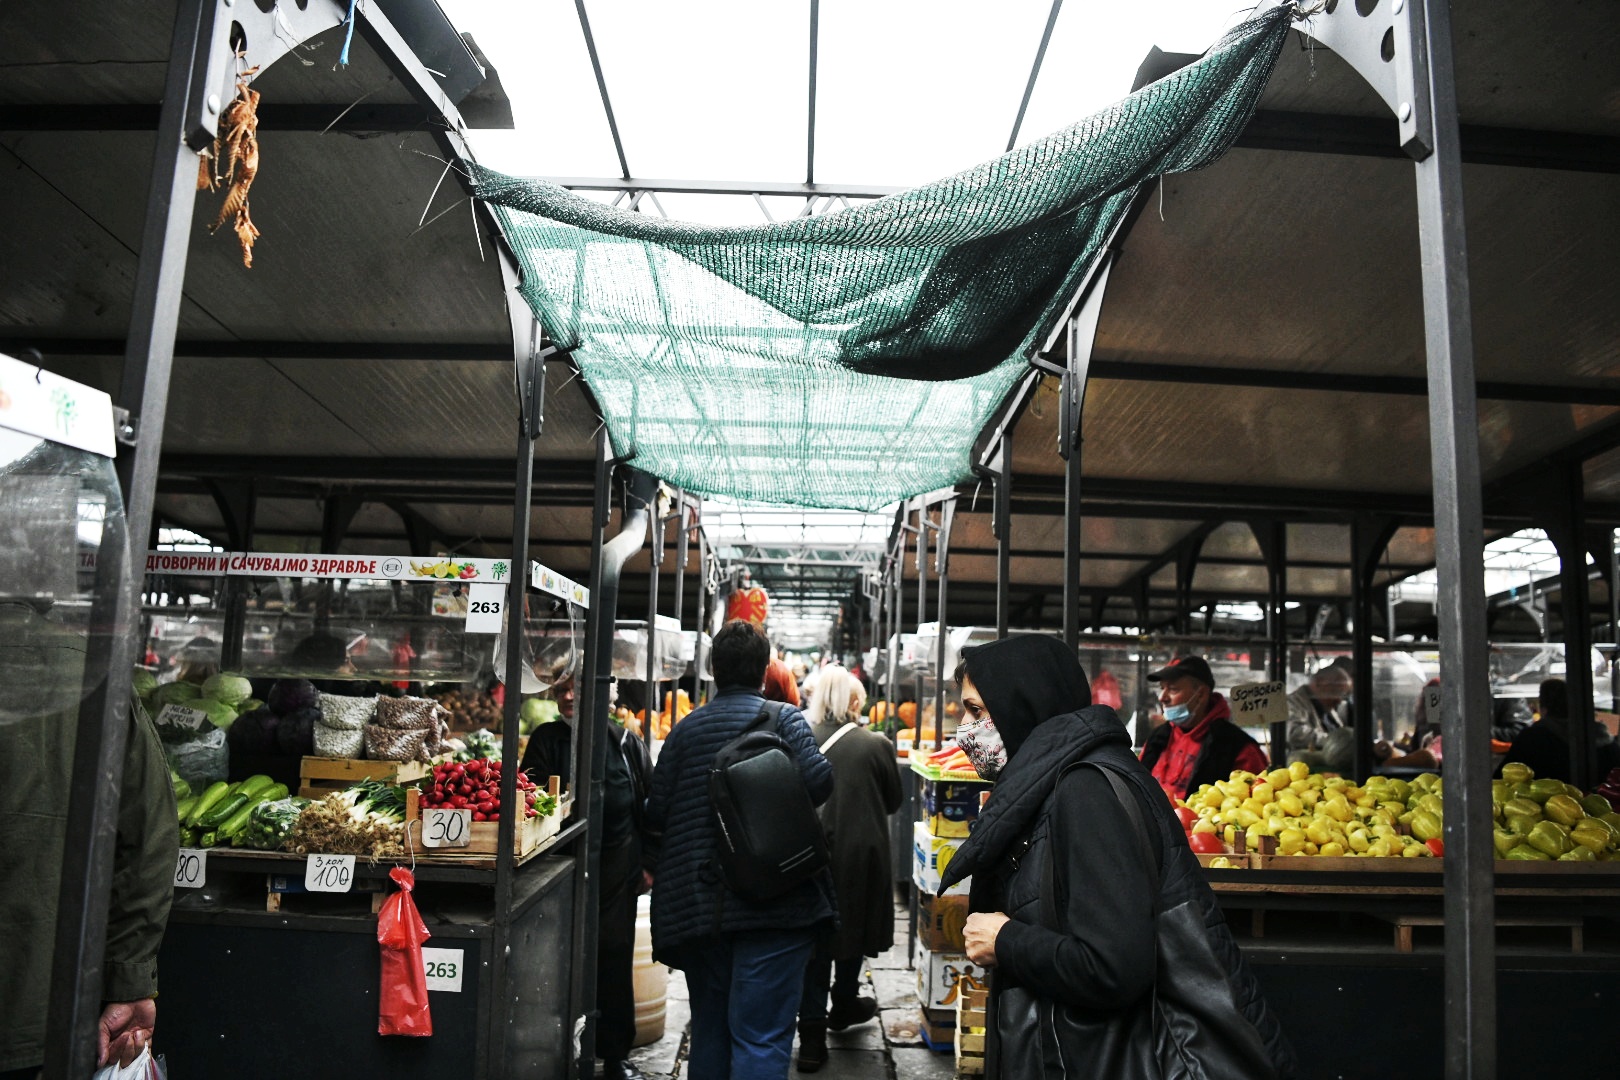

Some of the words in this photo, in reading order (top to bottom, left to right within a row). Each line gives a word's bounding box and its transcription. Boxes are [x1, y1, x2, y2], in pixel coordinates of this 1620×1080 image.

[145, 555, 217, 571] ДГОВОРНИ
[230, 556, 308, 572] САЧУВАЈМО
[310, 559, 377, 575] ЗДРАВЉЕ
[470, 601, 500, 614] 263
[430, 811, 464, 842] 30
[176, 854, 200, 883] 80
[315, 856, 324, 868] 3
[313, 865, 350, 888] 100
[425, 961, 457, 979] 263
